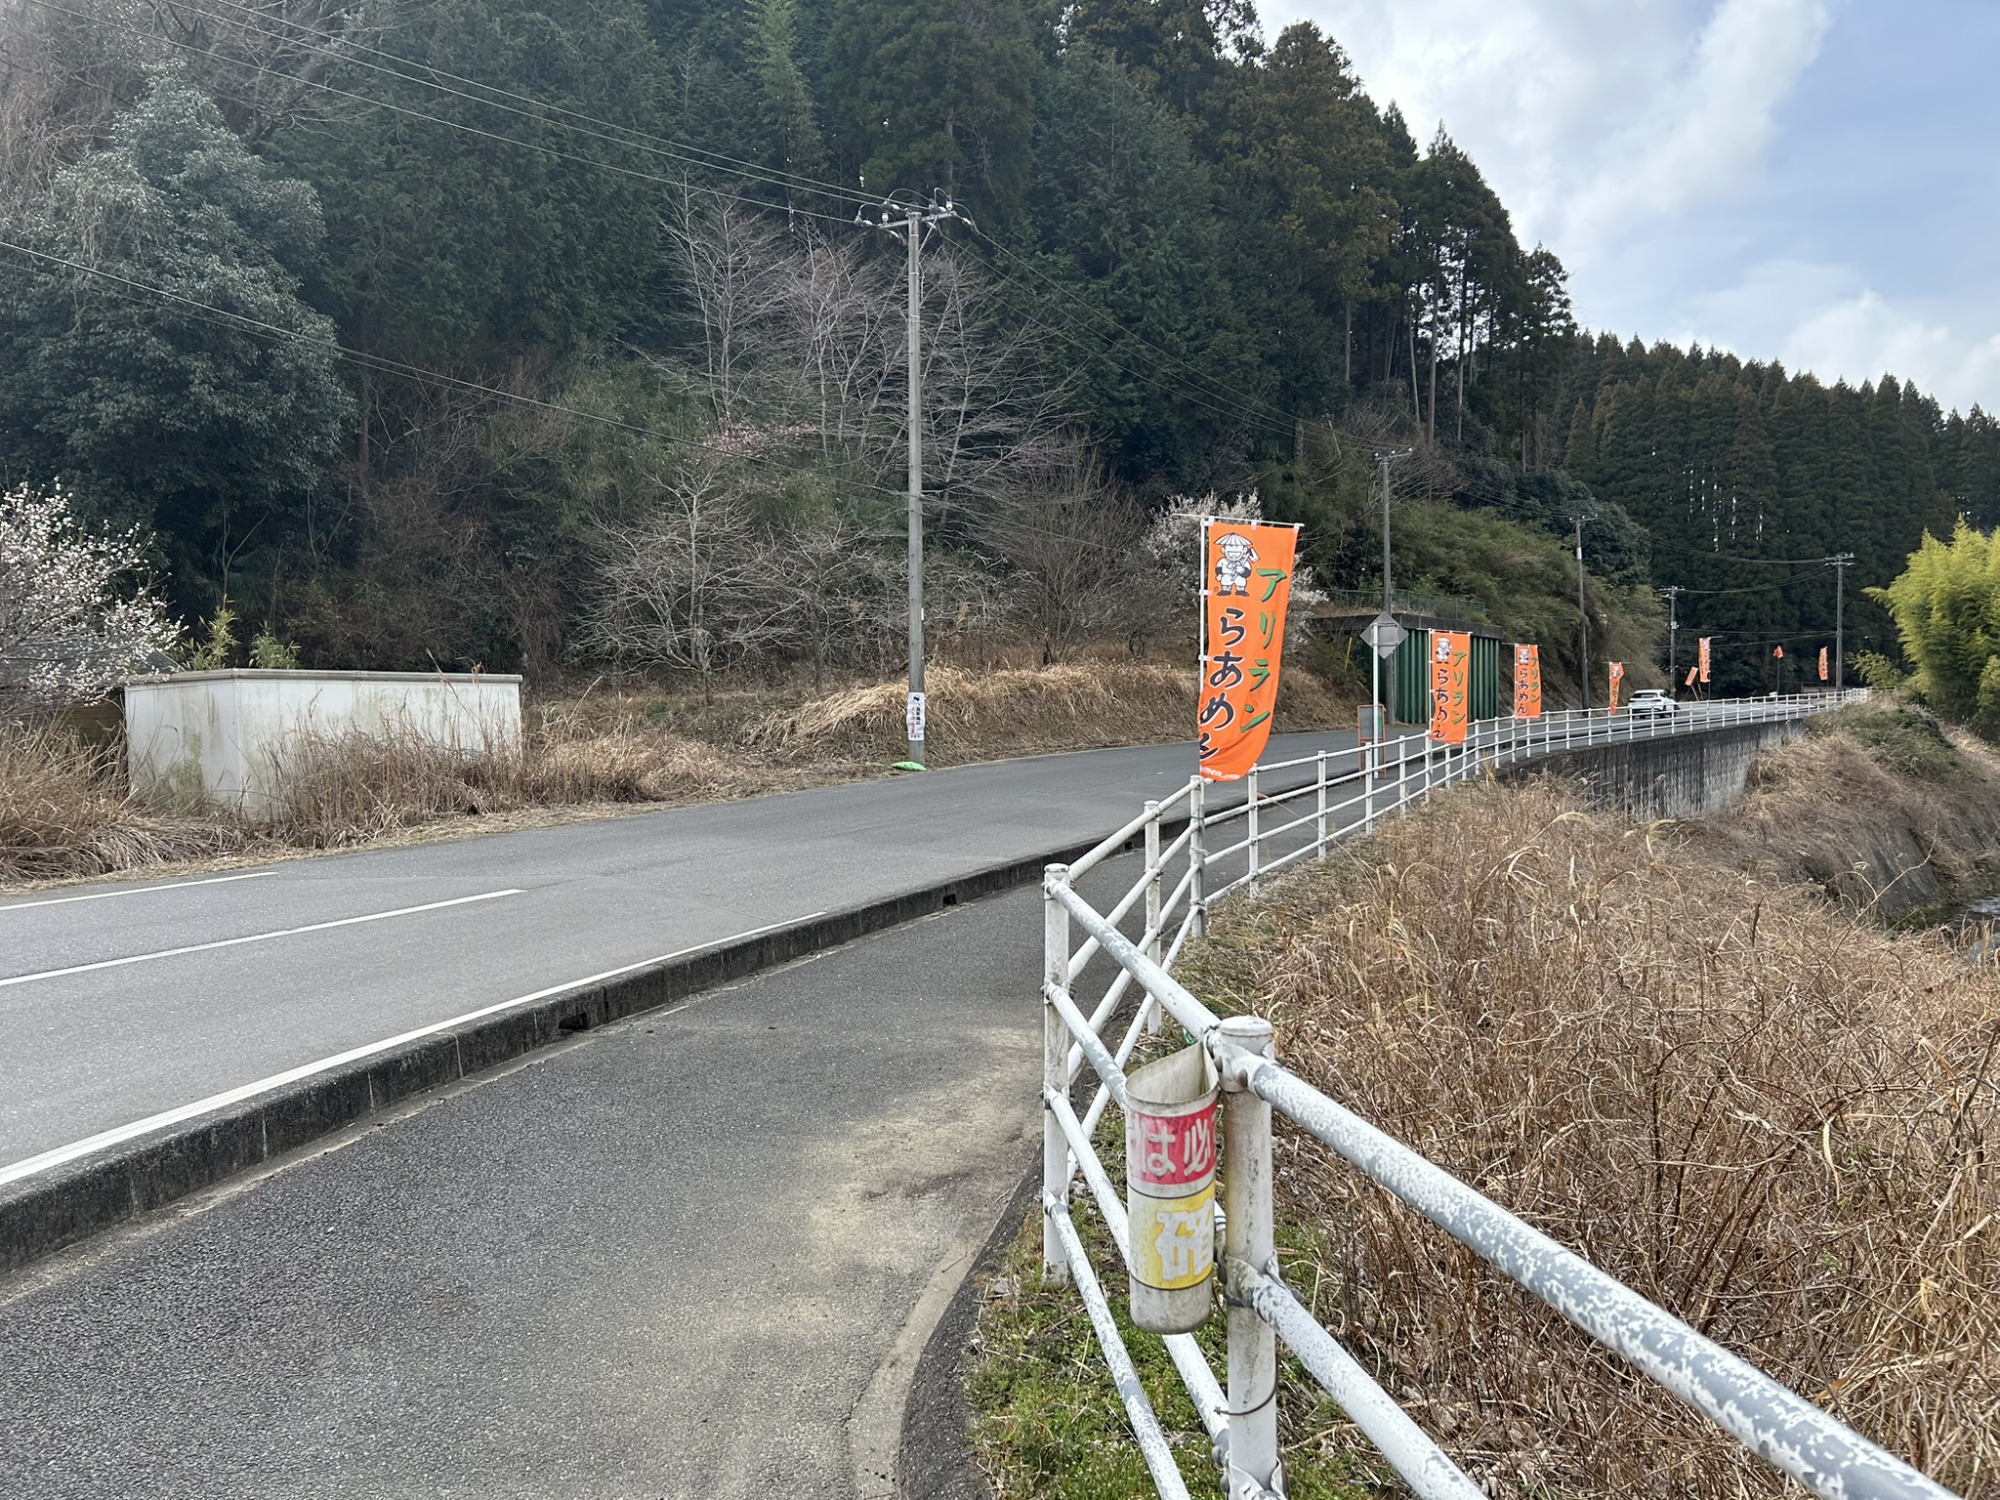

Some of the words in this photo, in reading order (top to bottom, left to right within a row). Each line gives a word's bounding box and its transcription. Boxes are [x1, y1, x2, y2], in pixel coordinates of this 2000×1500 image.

[1239, 568, 1288, 733] アリラン
[1530, 656, 1541, 704] アリラン
[1451, 651, 1467, 725] アリラン
[1517, 669, 1529, 714] らあめん
[1130, 1112, 1216, 1177] は必
